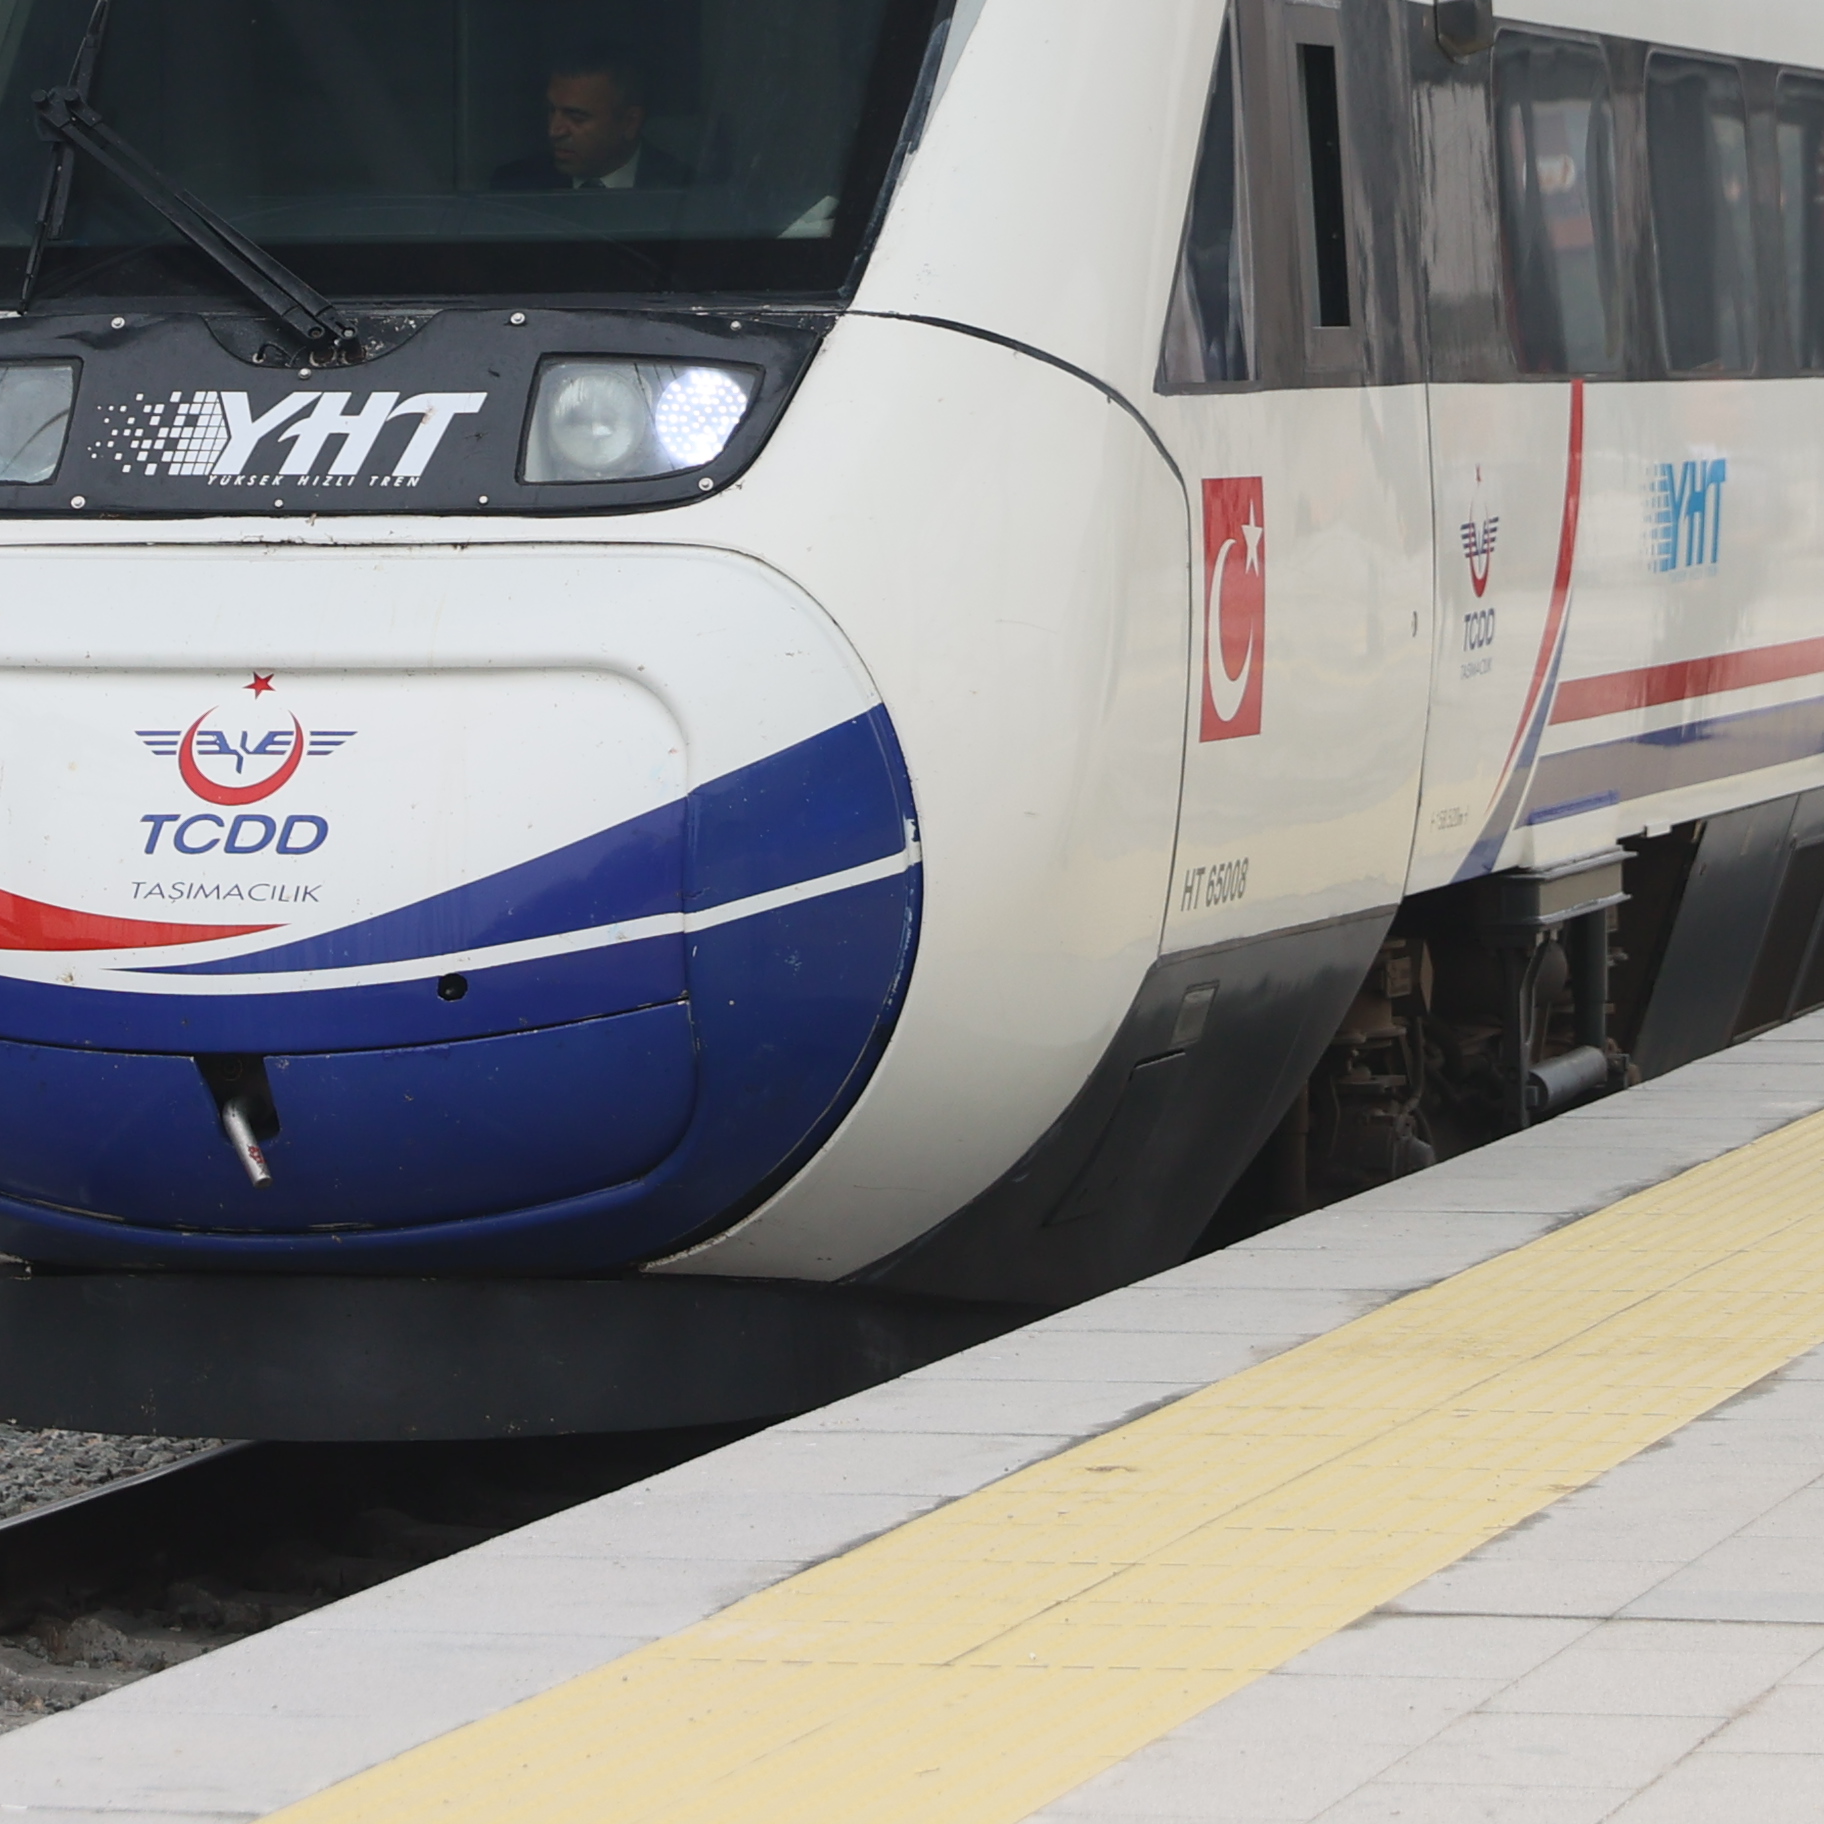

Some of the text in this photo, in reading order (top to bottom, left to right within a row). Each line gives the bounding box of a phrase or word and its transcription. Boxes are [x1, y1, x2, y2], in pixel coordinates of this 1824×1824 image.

[210, 390, 488, 477] YHT
[207, 474, 421, 488] YÜKSEK HIZLI TREN
[1663, 458, 1726, 570] YHT
[1463, 607, 1495, 652] TCDD
[139, 813, 329, 855] TCDD
[131, 881, 323, 904] TAŞIMACILIK
[1180, 856, 1249, 912] HT 65008
